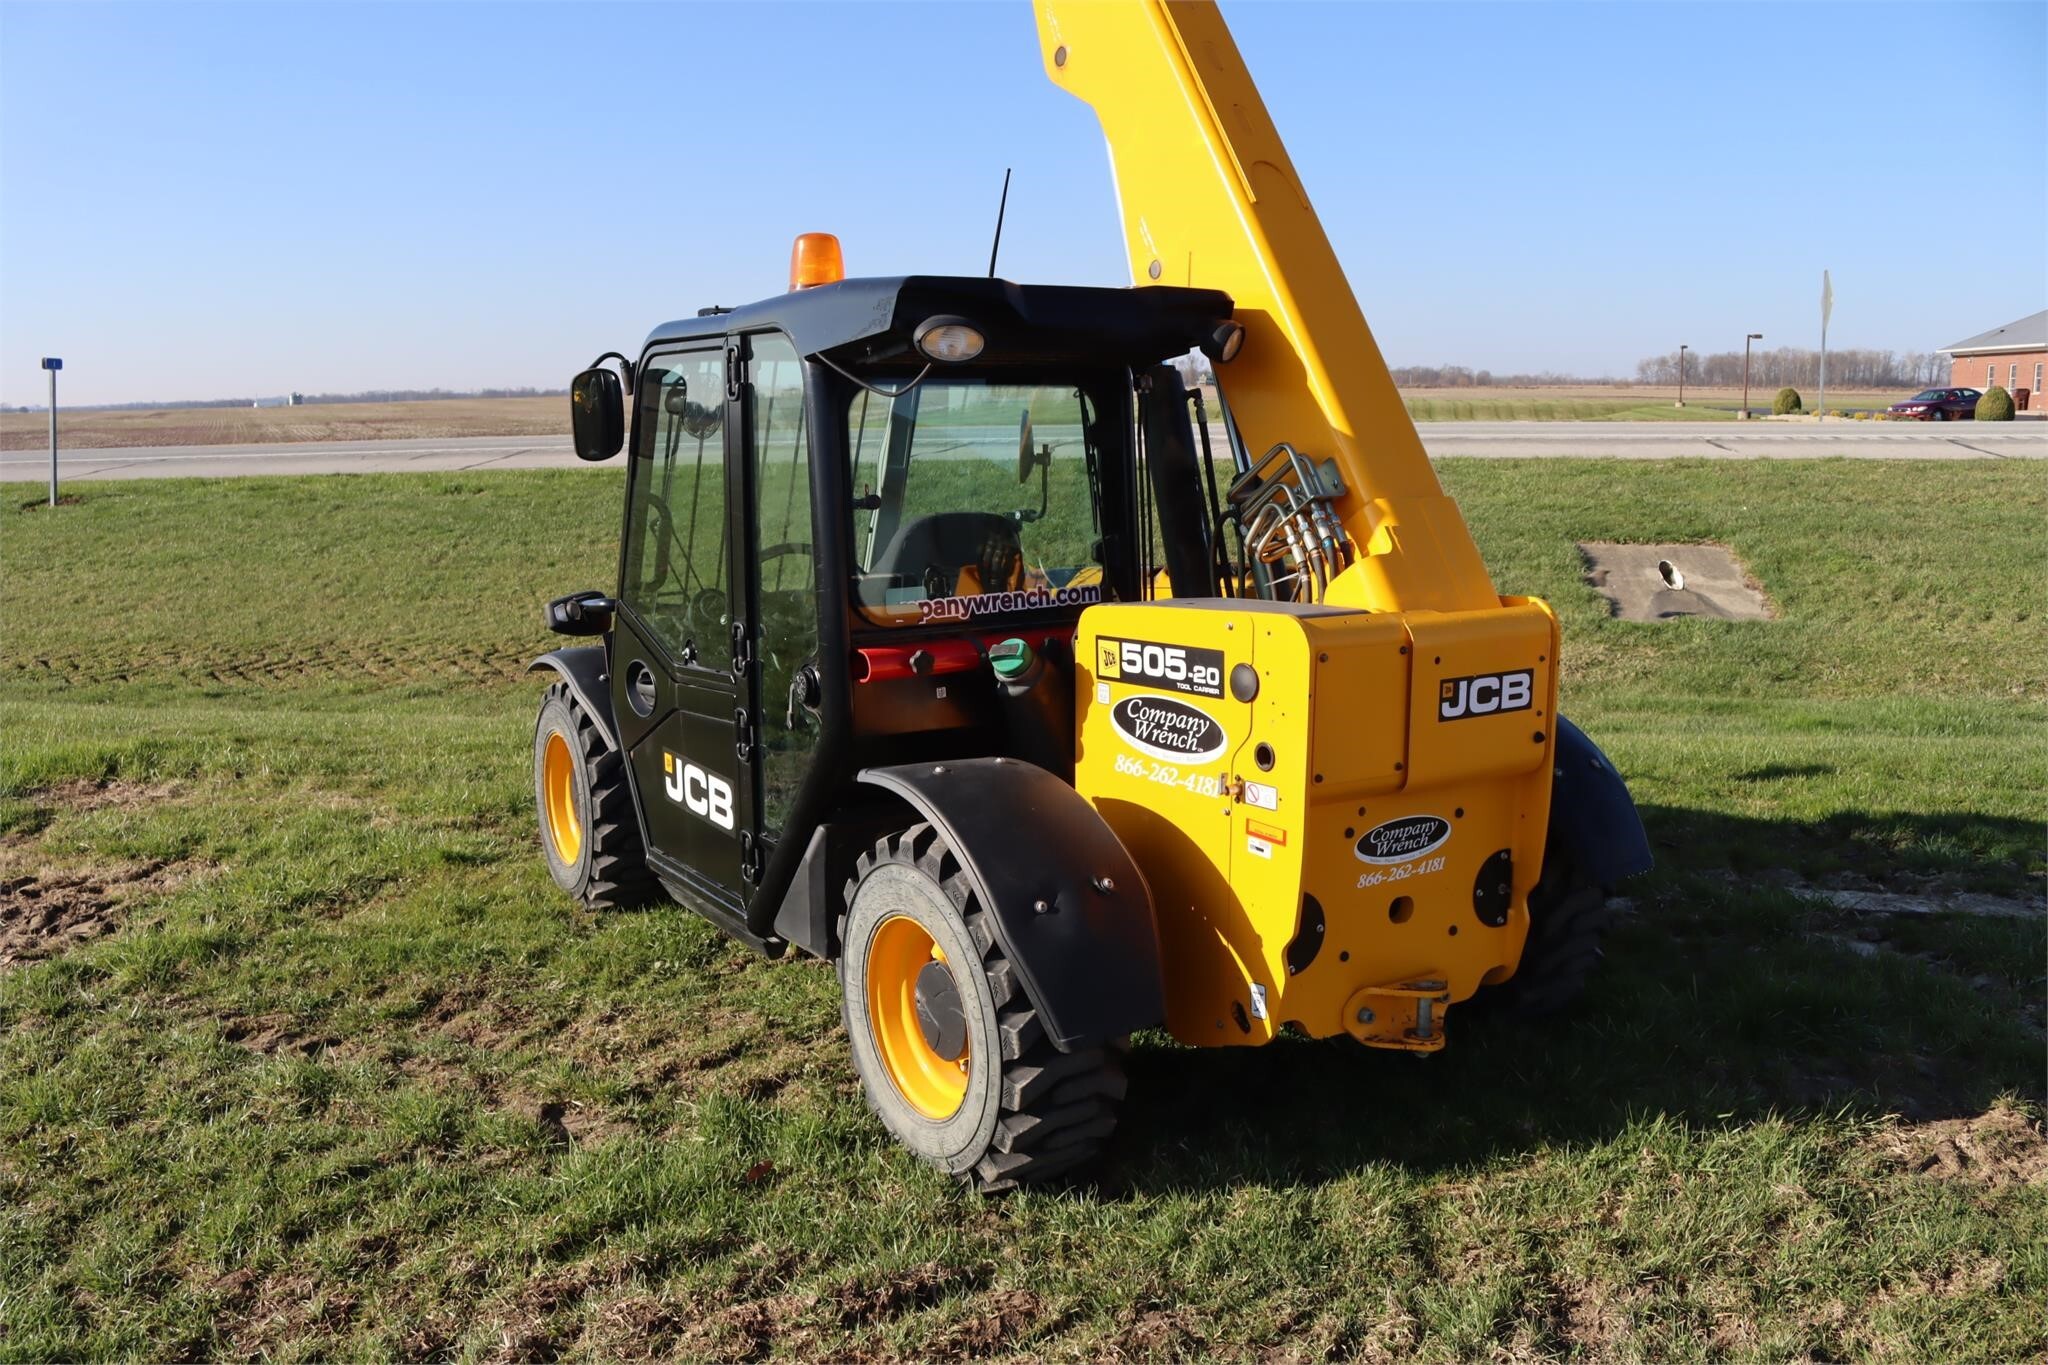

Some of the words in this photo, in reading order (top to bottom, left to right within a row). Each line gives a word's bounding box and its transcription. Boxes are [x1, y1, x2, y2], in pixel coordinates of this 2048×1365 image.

[1176, 682, 1192, 691] TOOL
[1193, 685, 1220, 695] CARRIER
[1442, 673, 1531, 717] JCB
[1127, 699, 1210, 737] Company
[1135, 719, 1198, 751] Wrench
[1114, 753, 1221, 799] 866-262-4181
[665, 757, 734, 830] JCB
[1370, 820, 1439, 844] Company
[1377, 833, 1429, 857] Wrench
[1356, 856, 1446, 889] 866-262-4181
